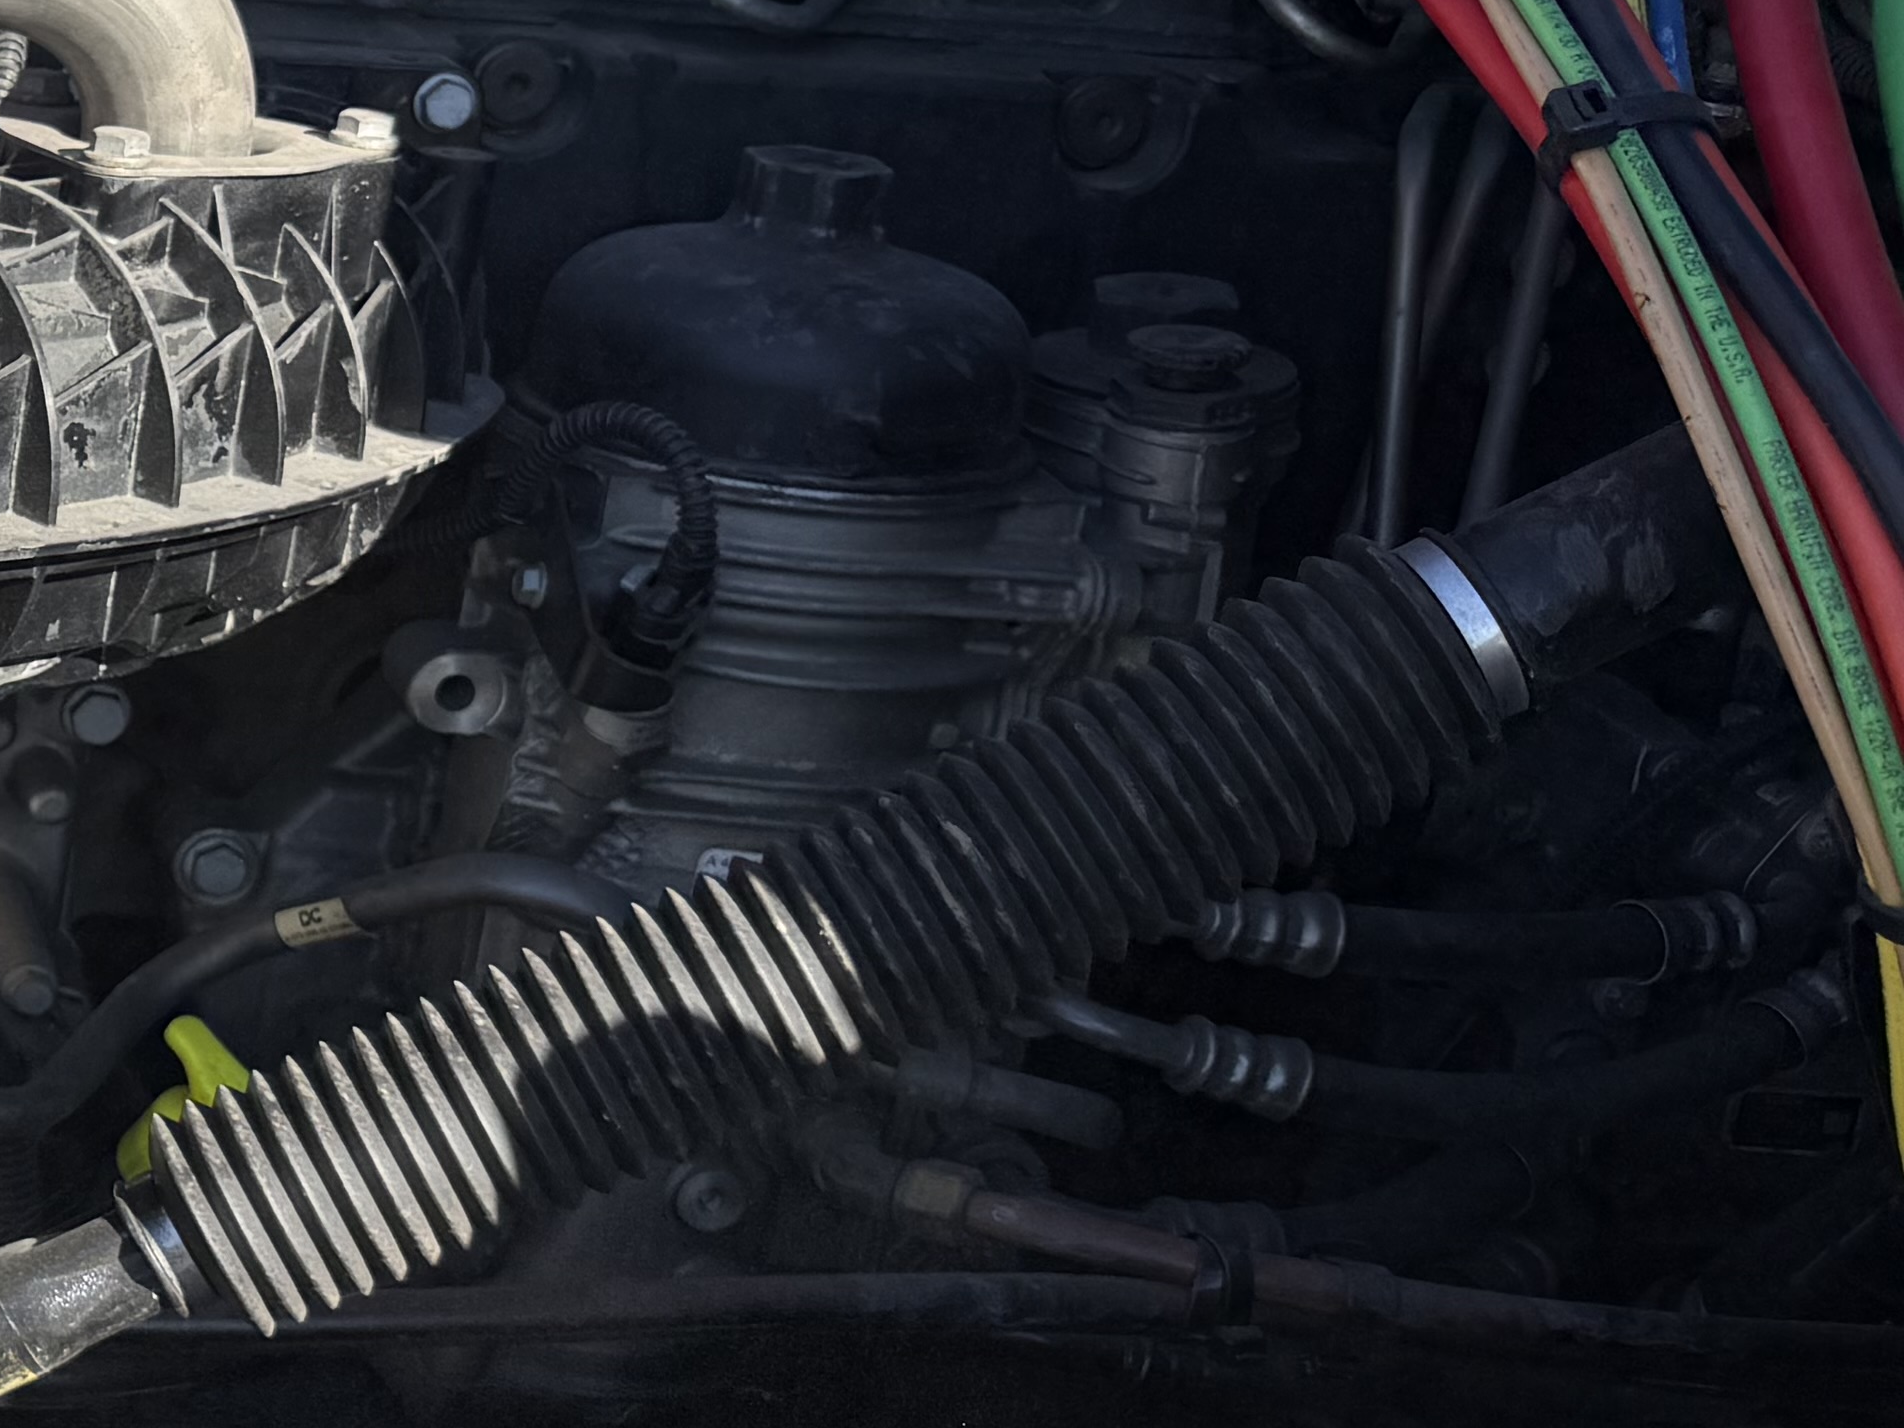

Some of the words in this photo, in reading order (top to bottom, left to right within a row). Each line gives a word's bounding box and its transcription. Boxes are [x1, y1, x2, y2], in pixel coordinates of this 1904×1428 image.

[1658, 213, 1707, 280] EXTRUDED
[1702, 305, 1728, 333] THE
[298, 907, 324, 928] DC
